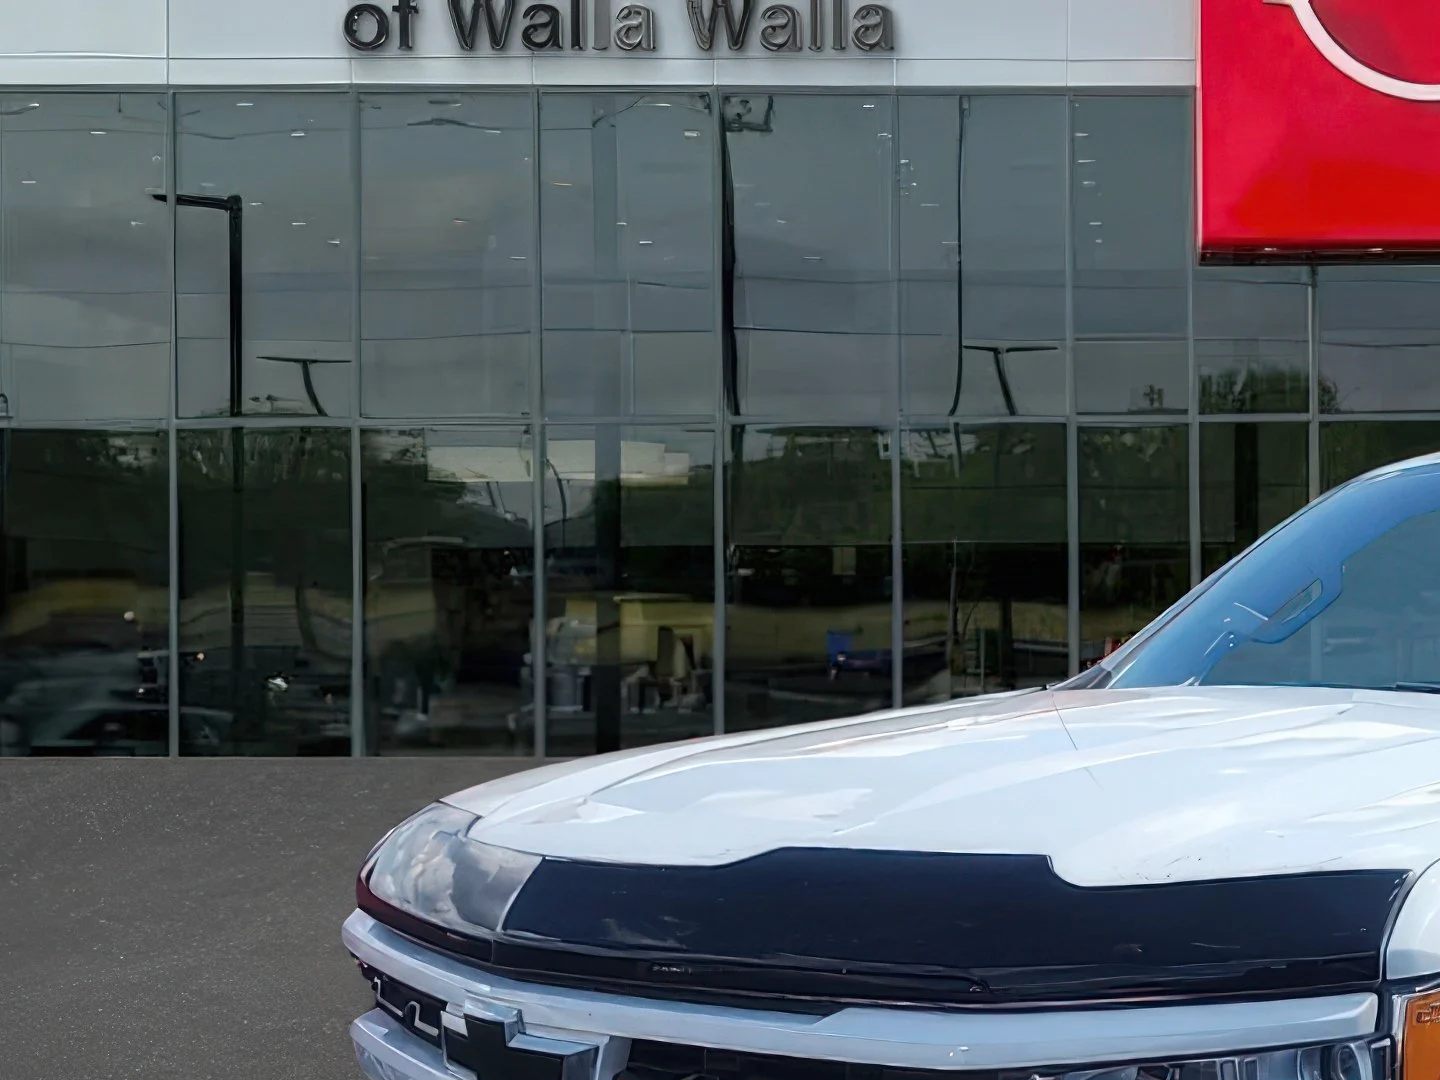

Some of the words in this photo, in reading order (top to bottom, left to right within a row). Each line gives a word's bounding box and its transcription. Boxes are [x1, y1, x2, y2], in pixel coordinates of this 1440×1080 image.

[343, 0, 419, 50] of
[446, 0, 656, 51] Walla
[686, 0, 895, 51] Walla
